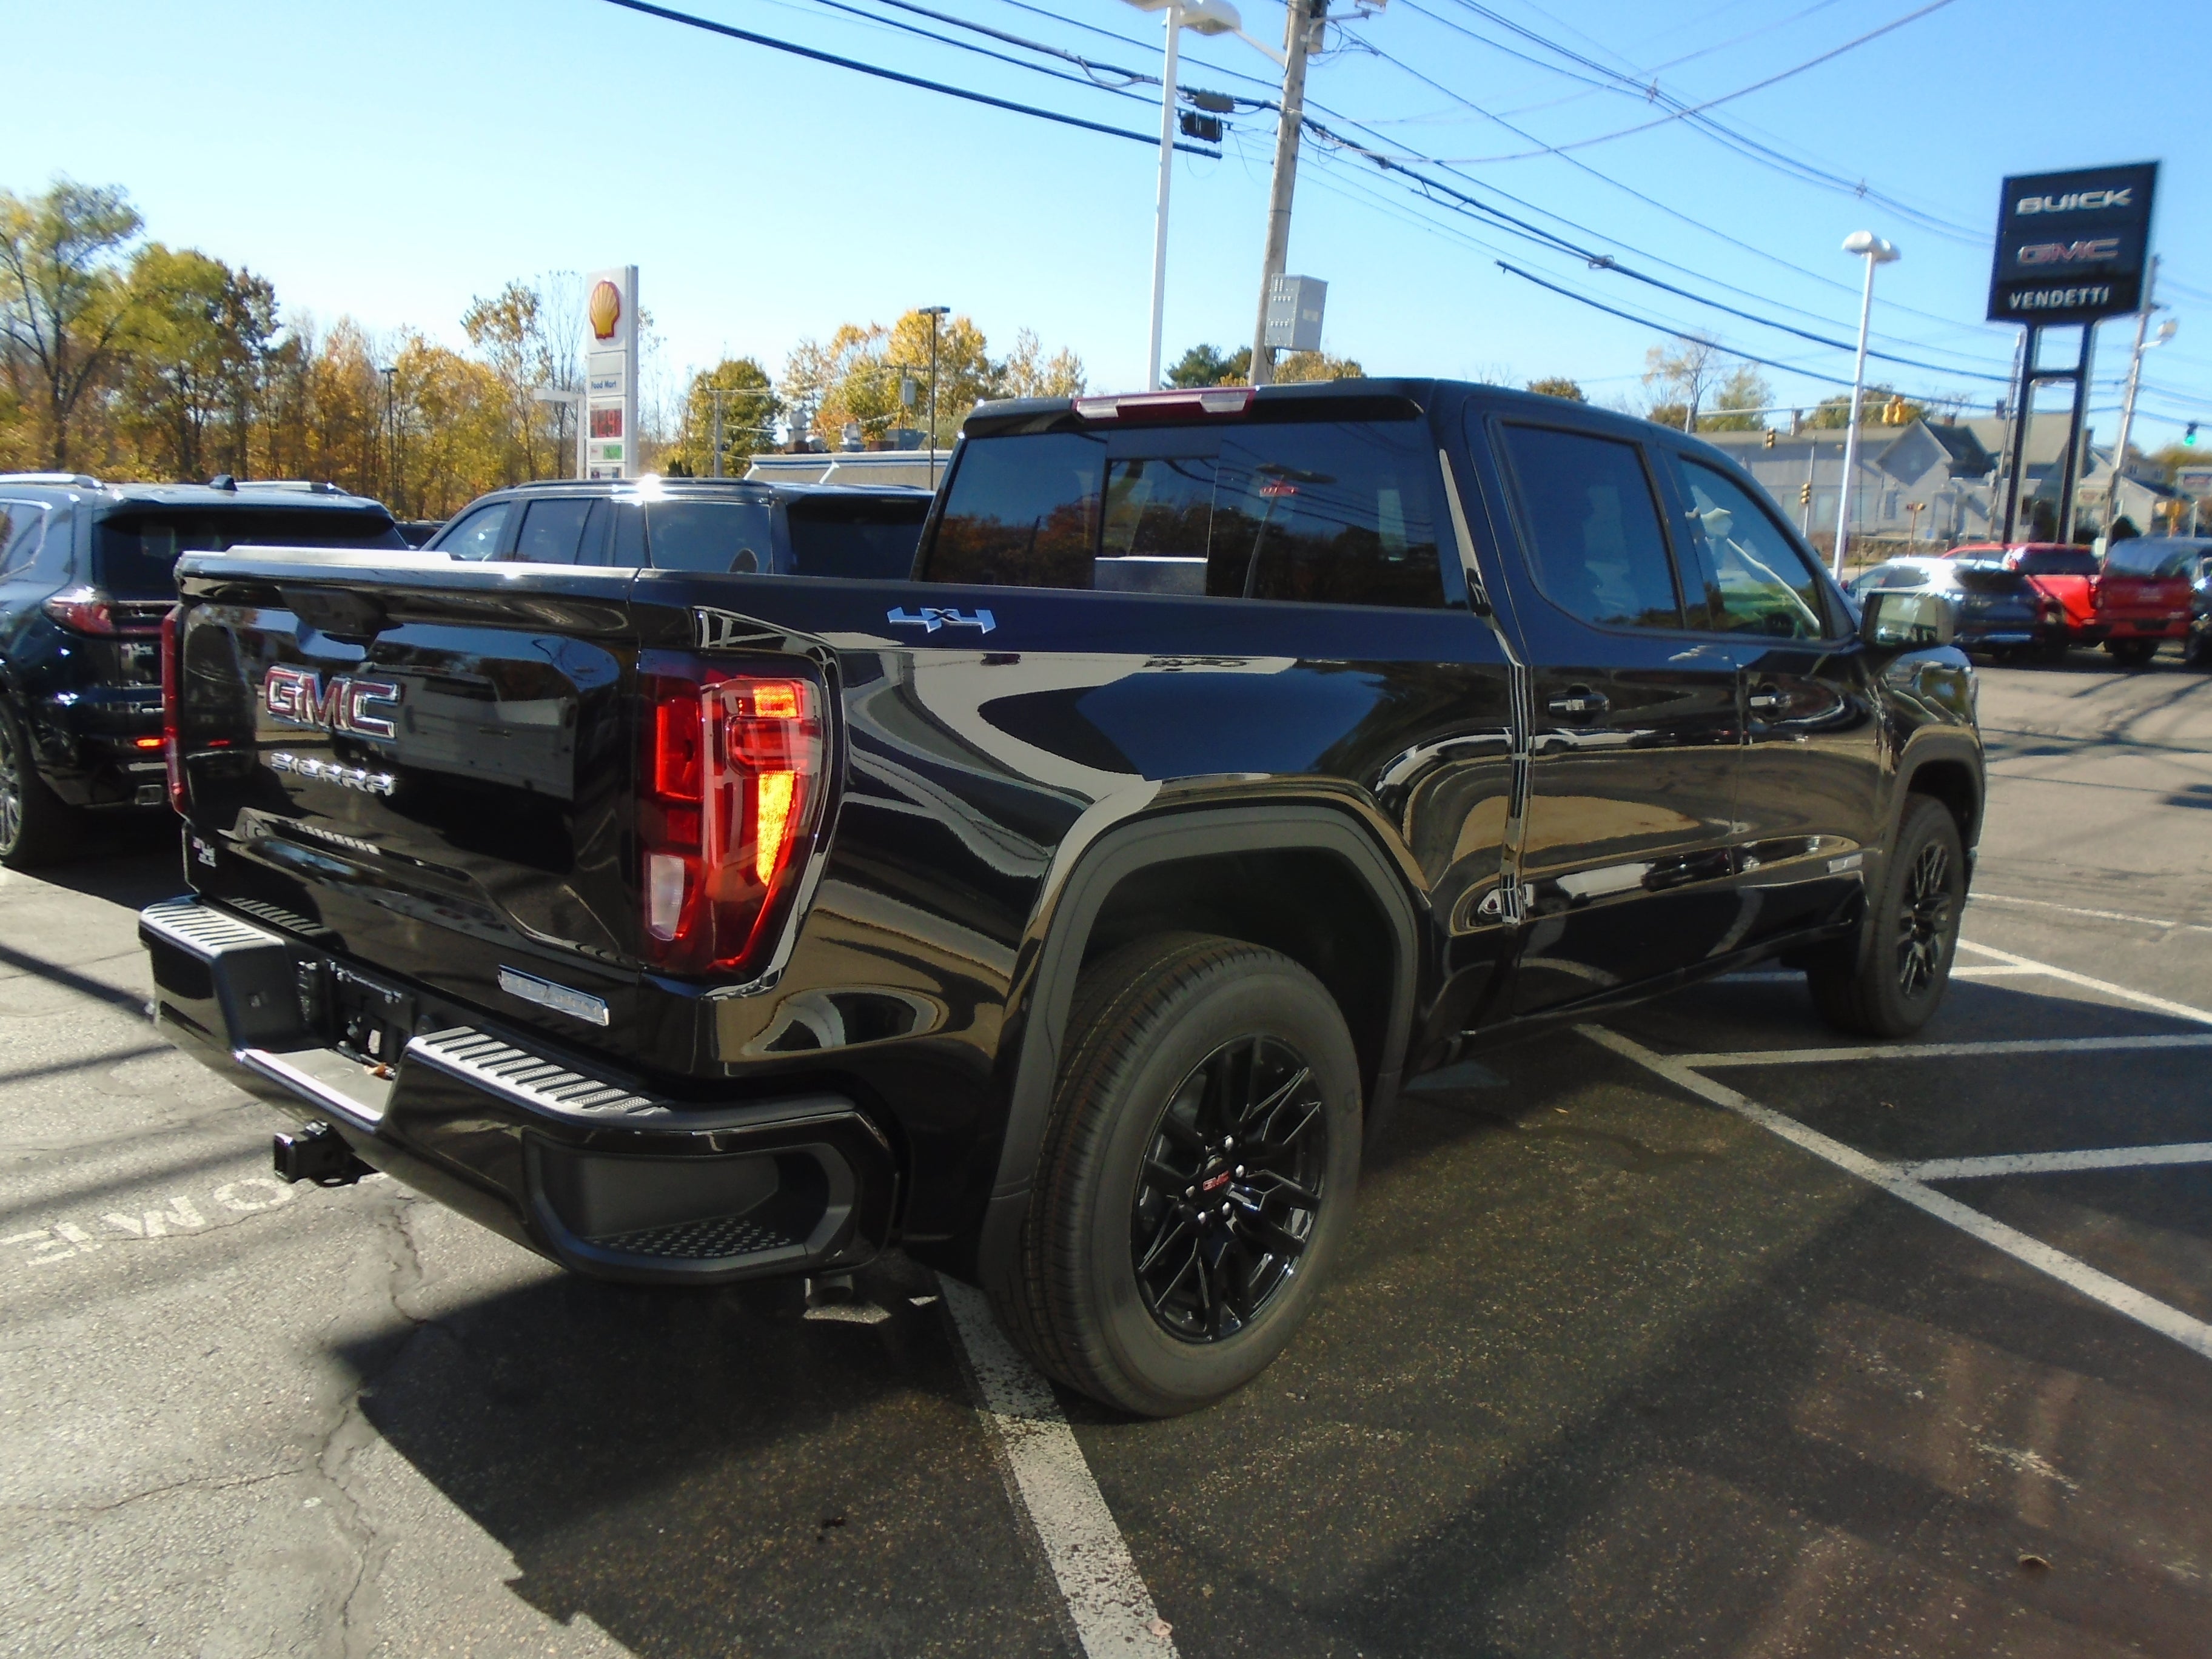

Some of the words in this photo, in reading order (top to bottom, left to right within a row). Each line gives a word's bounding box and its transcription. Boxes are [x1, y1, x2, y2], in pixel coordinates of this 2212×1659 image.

[2016, 188, 2133, 215] BUICK
[2017, 238, 2120, 264] GMC
[2008, 287, 2110, 309] VENDETTI
[591, 380, 603, 389] Food
[605, 380, 617, 389] Mart
[264, 665, 401, 741] GMC
[270, 751, 396, 796] SIERRA
[1202, 1170, 1230, 1191] GMC
